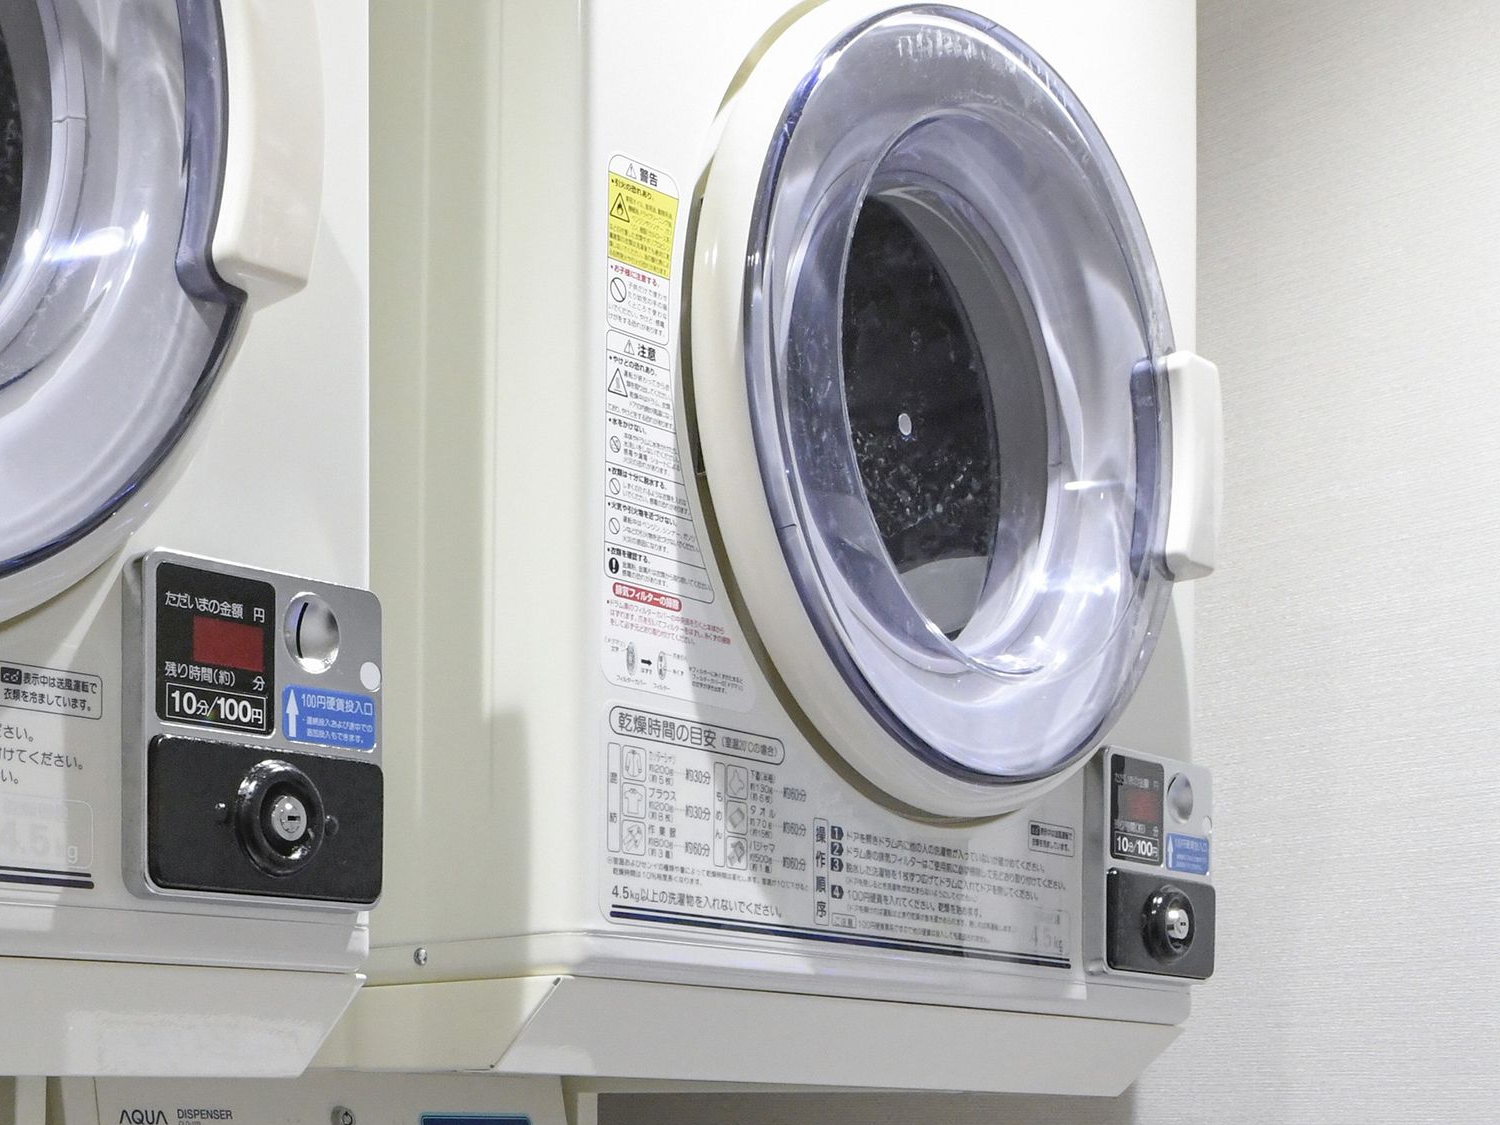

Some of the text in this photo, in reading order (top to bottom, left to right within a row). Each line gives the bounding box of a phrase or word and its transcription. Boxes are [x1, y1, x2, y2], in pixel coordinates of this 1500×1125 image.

[637, 343, 657, 362] 注意
[165, 591, 265, 623] ただいまの金額 円
[253, 676, 265, 691] 分
[171, 690, 264, 724] 10分/100円
[301, 693, 373, 716] 100円硬貨投入口
[618, 711, 717, 749] 乾燥時間の目安
[119, 1108, 234, 1125] AQUA DISPENSER
